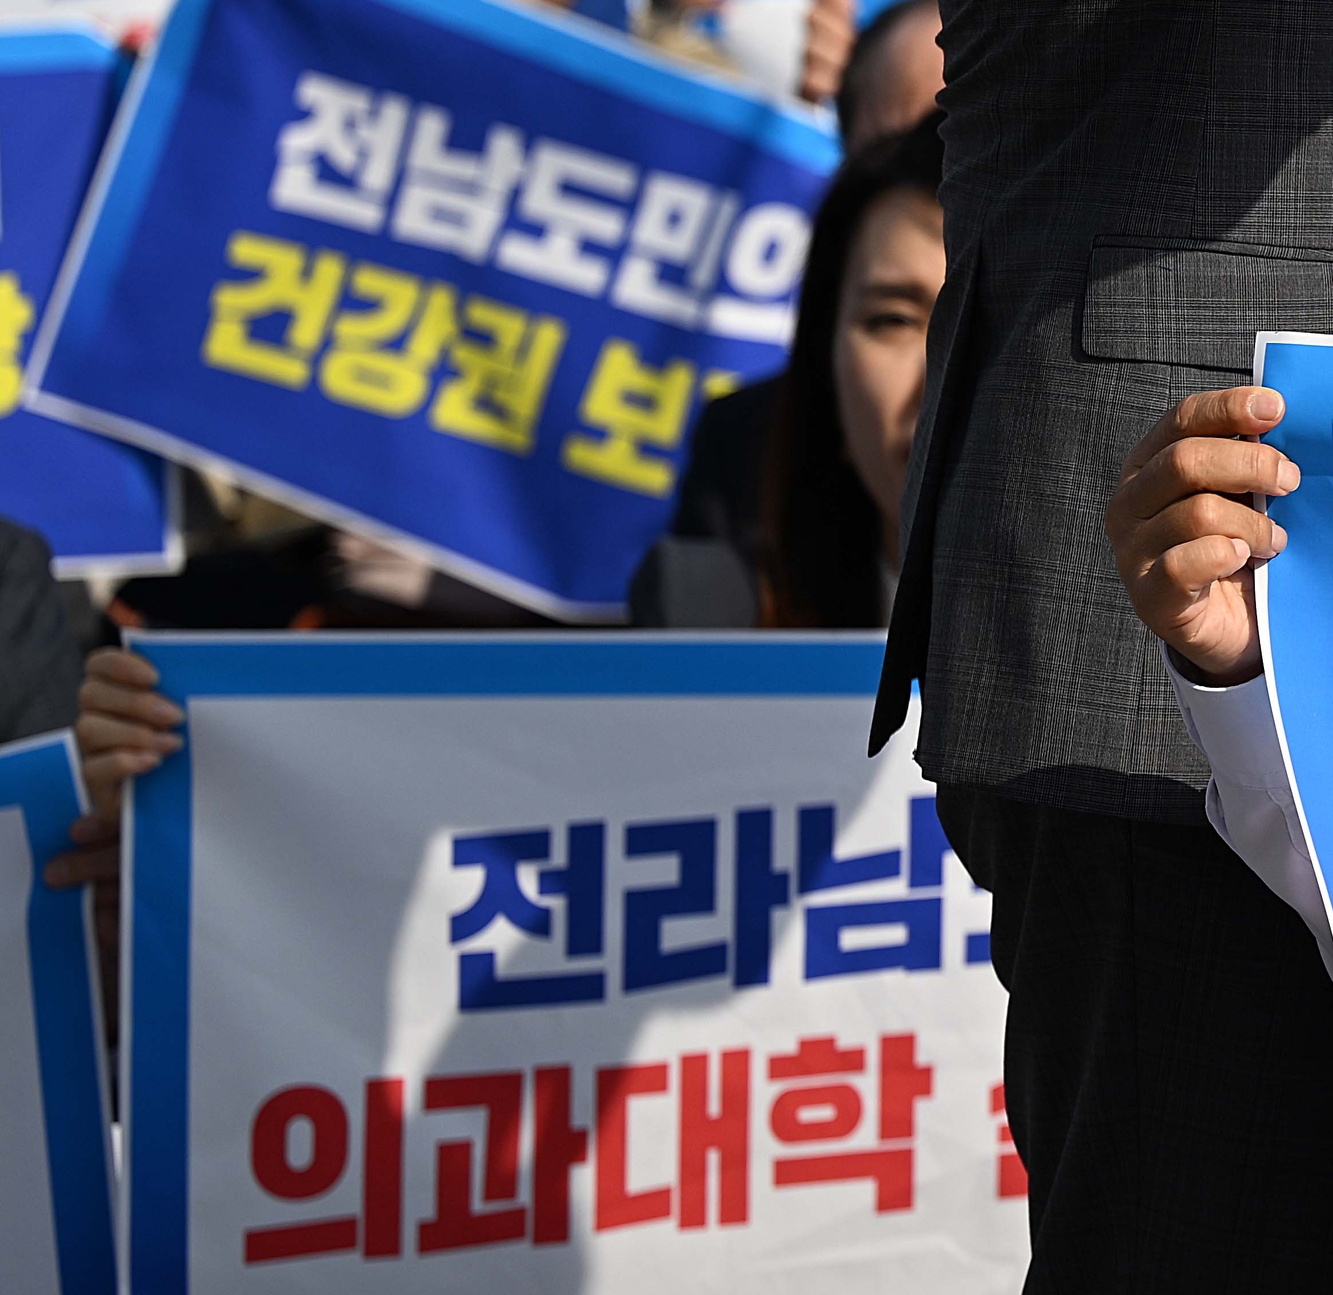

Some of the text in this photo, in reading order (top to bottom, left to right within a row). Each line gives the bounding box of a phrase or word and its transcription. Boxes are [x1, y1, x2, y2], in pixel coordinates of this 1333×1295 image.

[204, 229, 567, 456] 건강권
[560, 336, 745, 499] 보
[449, 796, 994, 1014] 전라남
[243, 1032, 935, 1267] 의과대학
